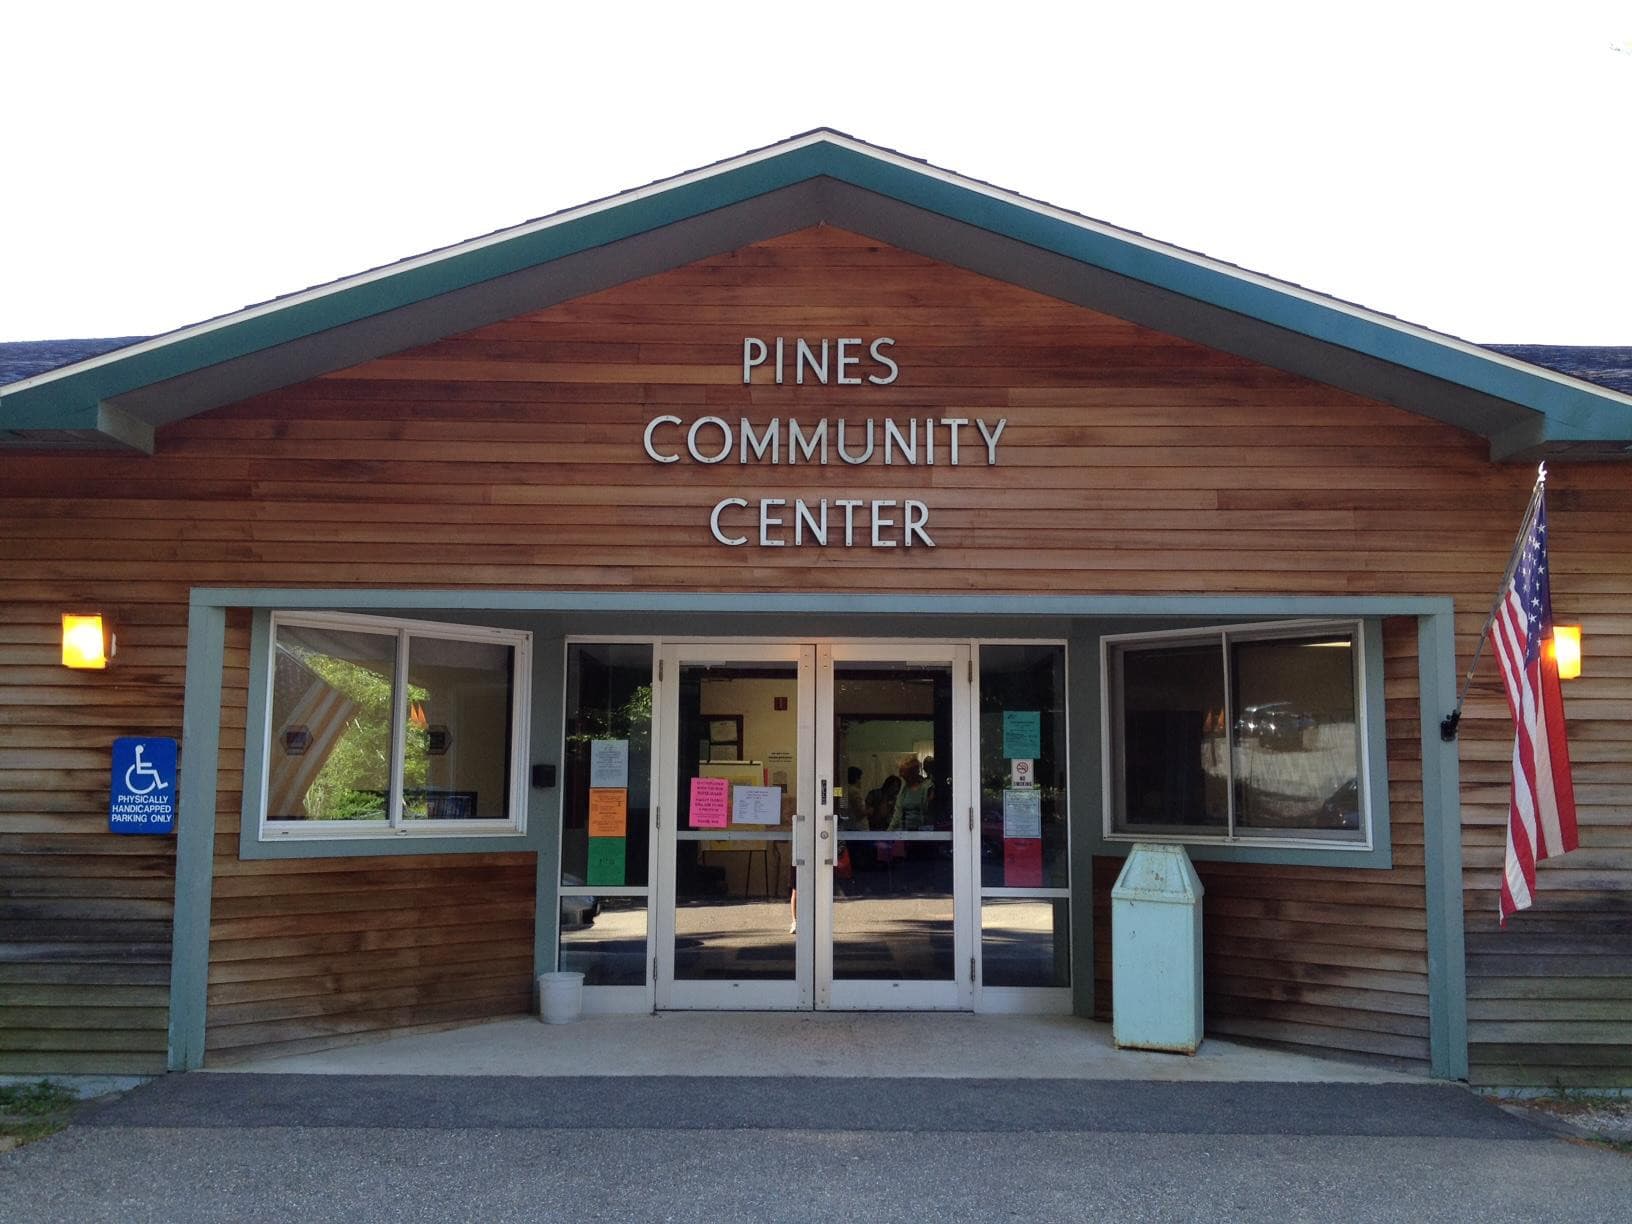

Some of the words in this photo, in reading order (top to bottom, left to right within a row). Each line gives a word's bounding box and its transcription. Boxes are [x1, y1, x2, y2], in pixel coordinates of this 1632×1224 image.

[743, 337, 899, 385] PINES
[643, 415, 1007, 465] COMMUNITY
[710, 498, 936, 547] CENTER
[112, 805, 171, 813] HANDICAPPED
[118, 795, 168, 803] PHYSICALLY
[111, 814, 147, 822] PARKING
[151, 814, 171, 822] ONLY
